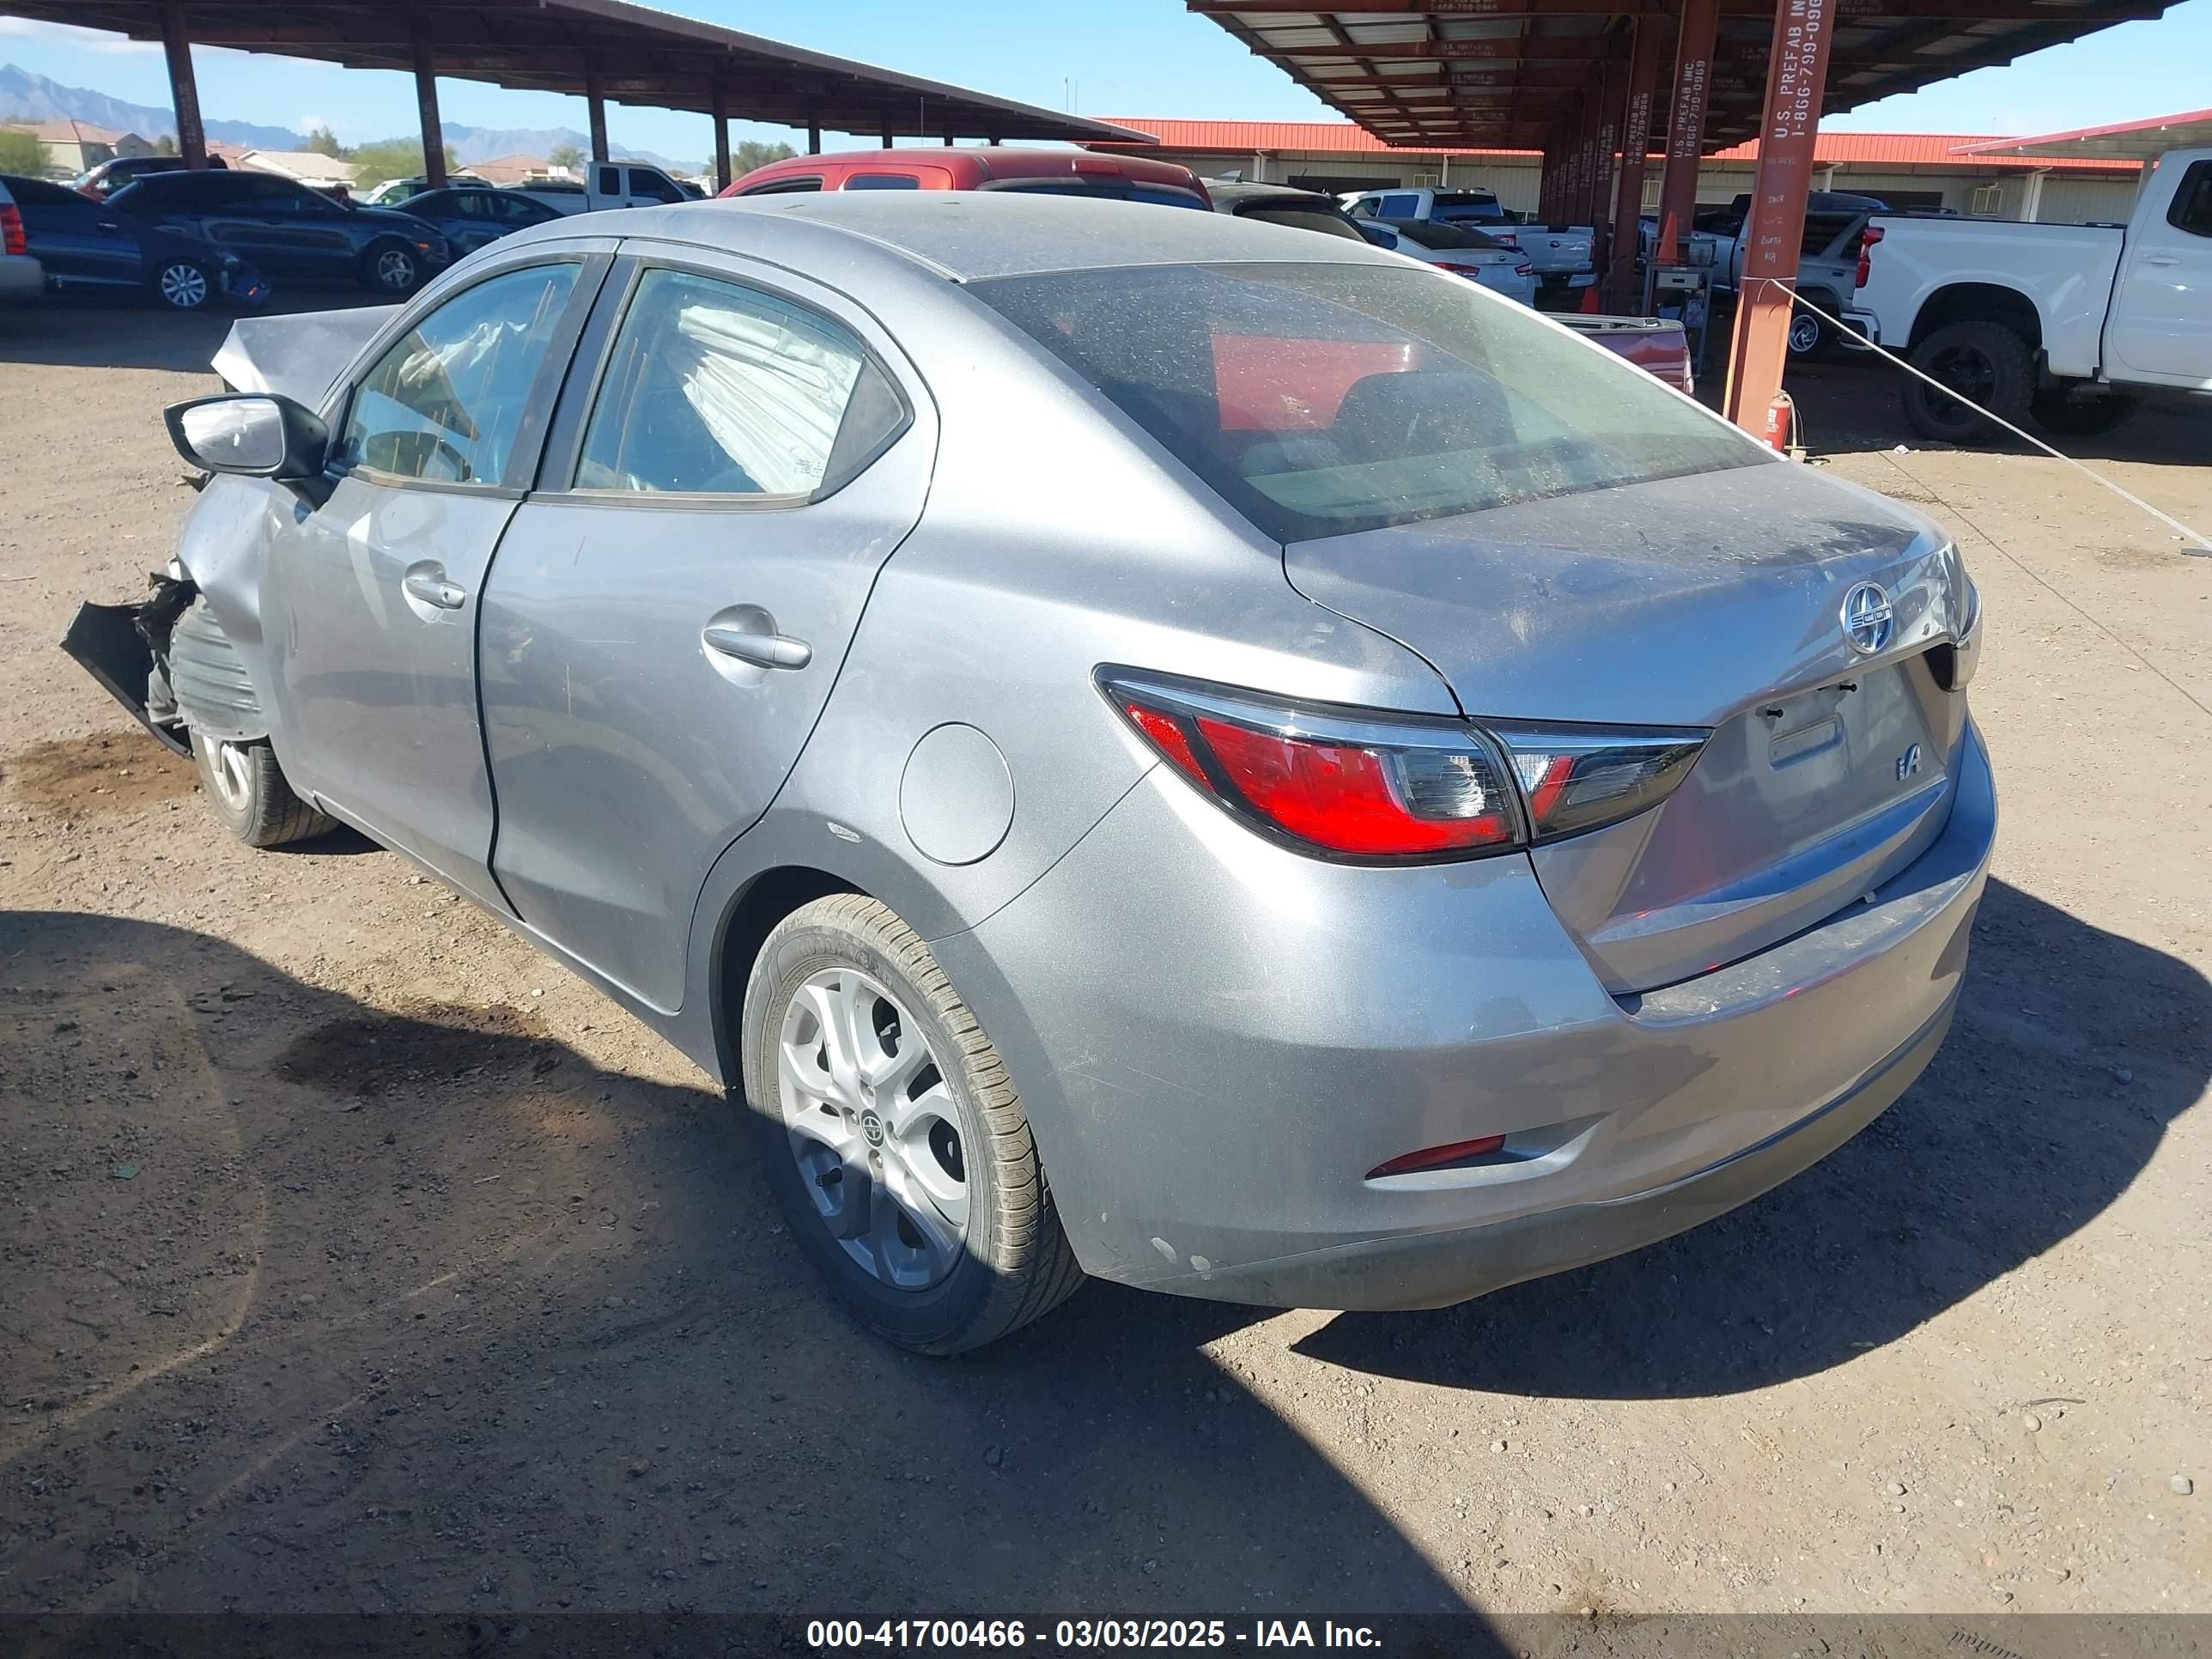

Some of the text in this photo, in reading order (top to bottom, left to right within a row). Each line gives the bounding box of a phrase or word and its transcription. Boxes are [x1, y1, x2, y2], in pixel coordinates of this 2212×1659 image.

[1780, 27, 1802, 95] PREFAB
[1674, 60, 1696, 158] U.S. PREFAB INC.
[1684, 60, 1705, 156] 1-866-799-0969
[1775, 106, 1792, 137] U.S.
[1850, 606, 1893, 628] SCION
[1895, 742, 1922, 781] iA
